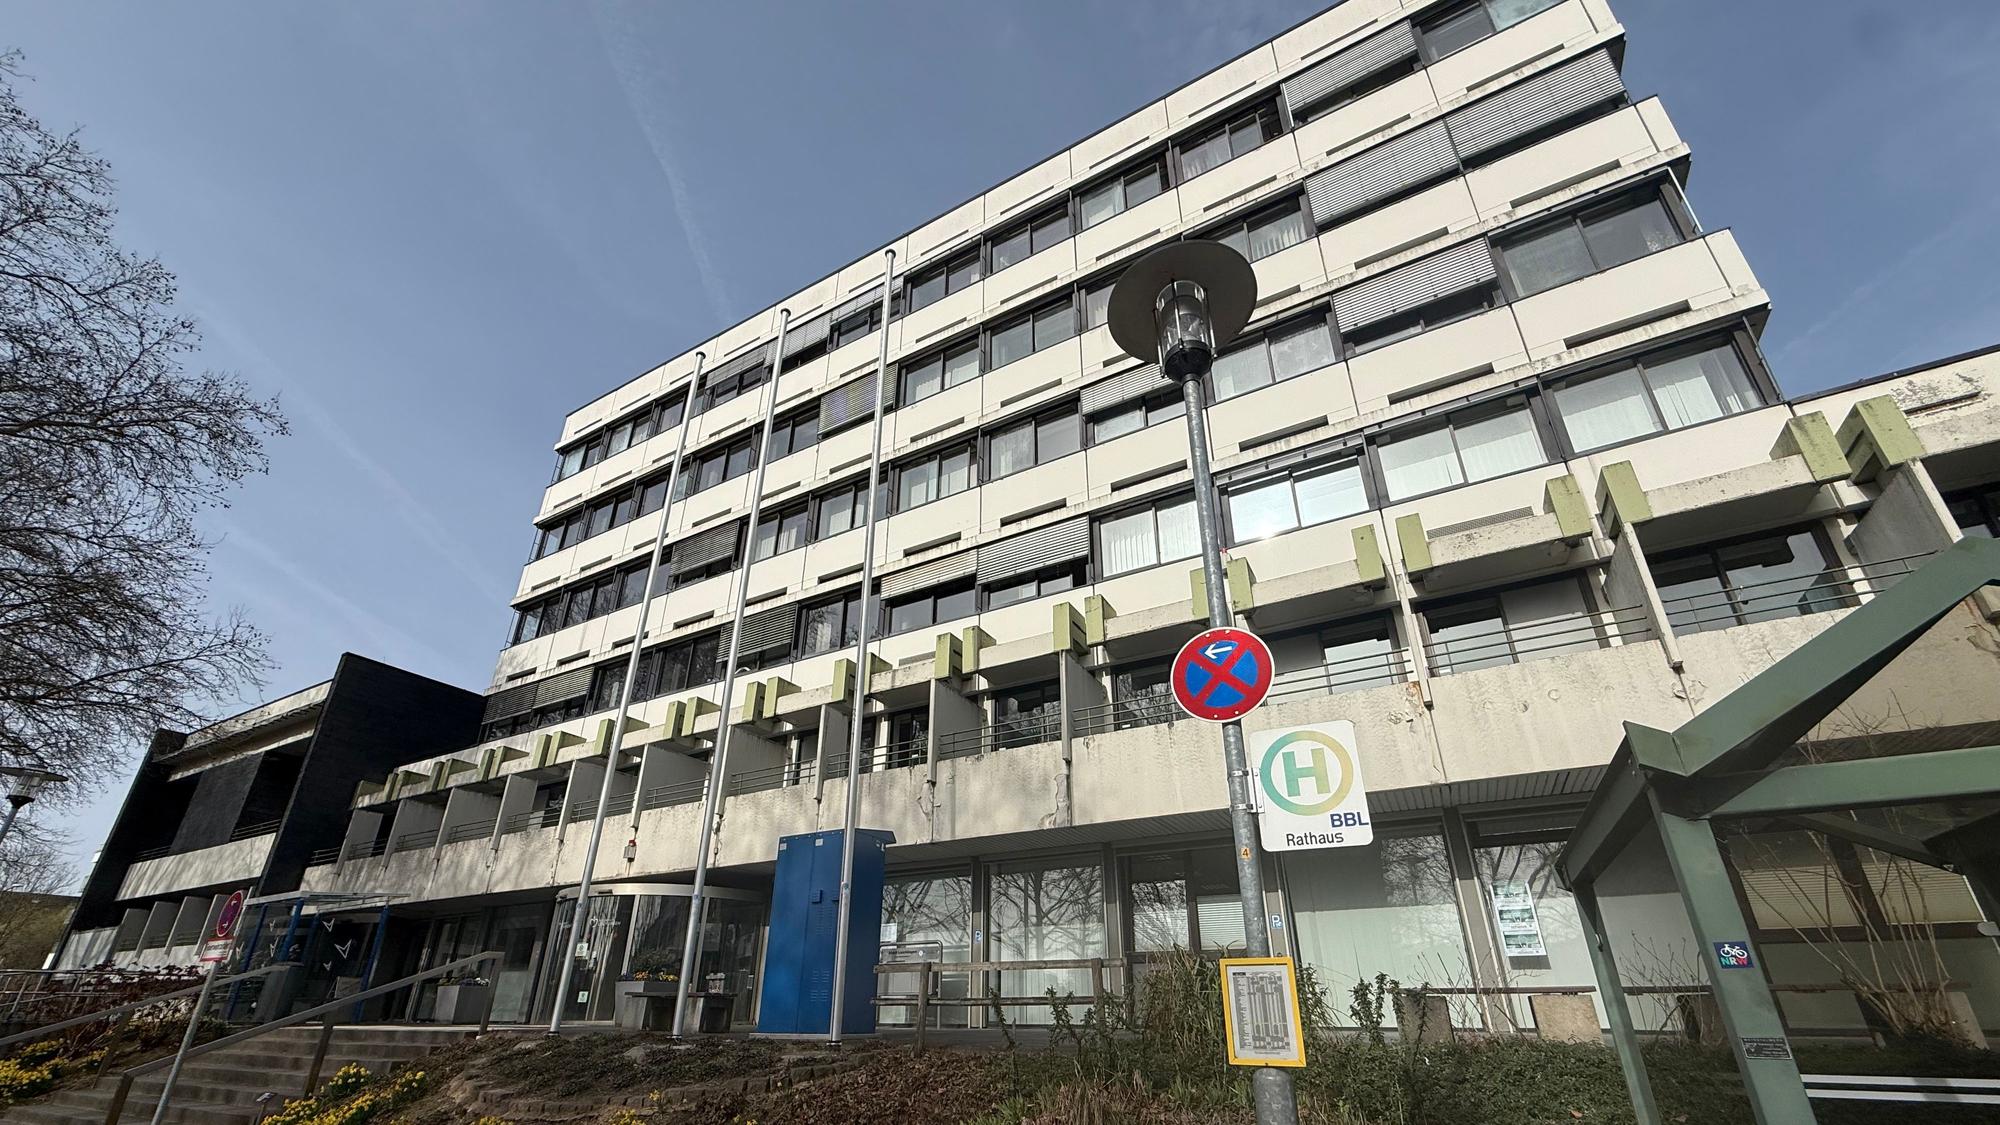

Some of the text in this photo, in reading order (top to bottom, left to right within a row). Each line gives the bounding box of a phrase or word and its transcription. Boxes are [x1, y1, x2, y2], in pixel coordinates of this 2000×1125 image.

[1282, 748, 1330, 797] H
[1330, 812, 1369, 828] BBL
[1286, 832, 1344, 847] Rathaus
[1720, 956, 1748, 966] NRW
